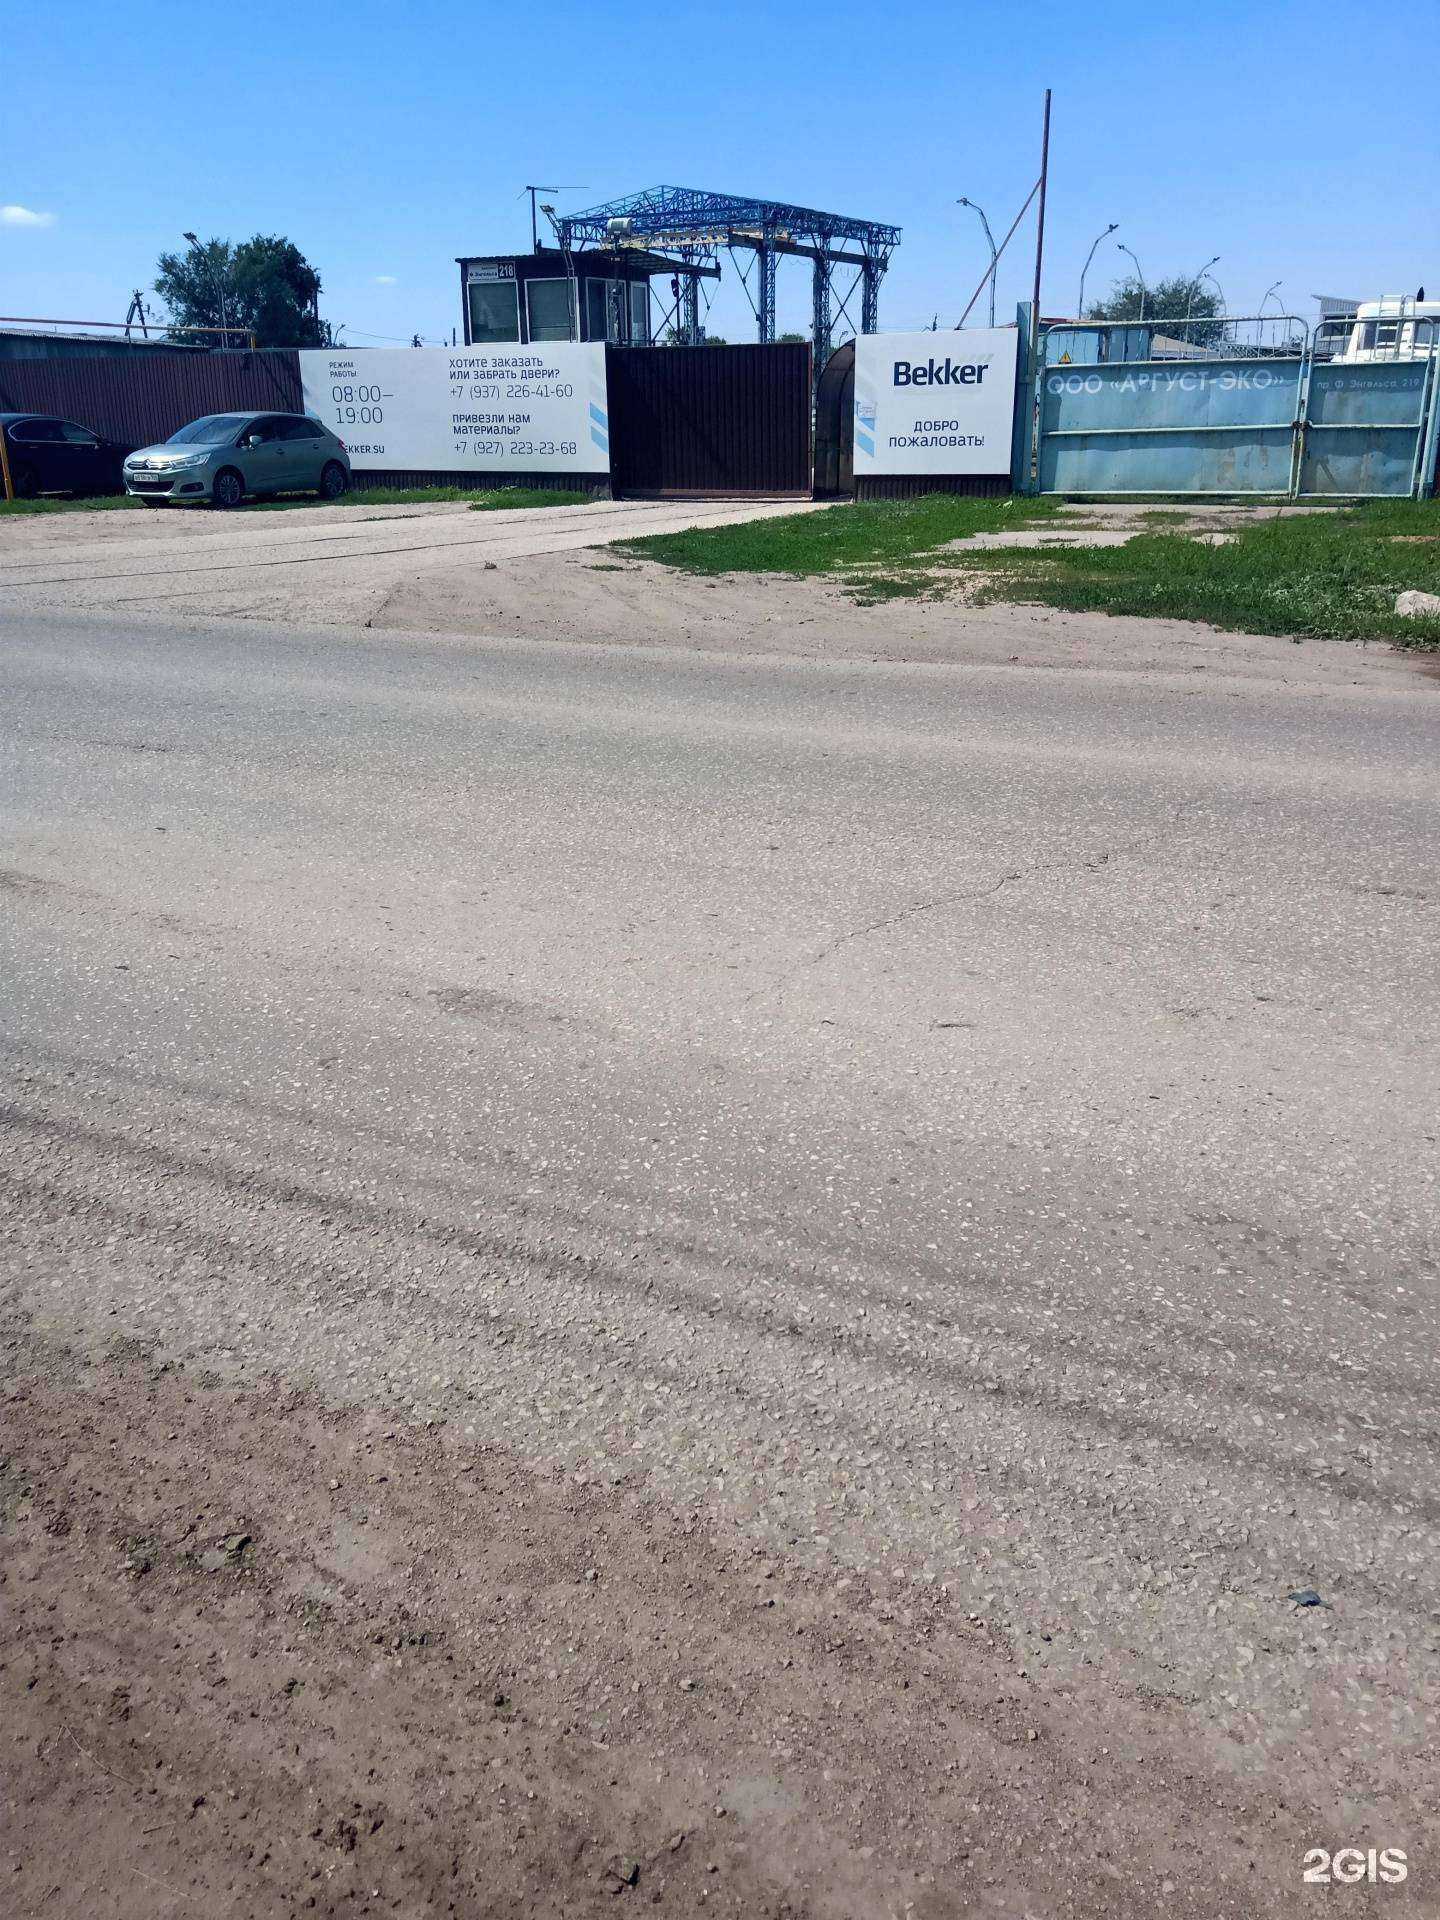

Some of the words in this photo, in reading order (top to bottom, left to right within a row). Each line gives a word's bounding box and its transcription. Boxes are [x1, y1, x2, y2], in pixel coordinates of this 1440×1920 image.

[893, 357, 989, 387] Bekker
[450, 385, 464, 398] +7
[469, 385, 500, 400] (937)
[506, 383, 573, 398] 226-41-60
[1047, 374, 1102, 395] ООО
[336, 407, 383, 424] 19:00
[914, 420, 959, 433] ДОБРО
[344, 445, 385, 454] EKKER.SU
[454, 441, 467, 454] +7
[473, 441, 504, 457] (927)
[510, 441, 577, 455] 223-23-68
